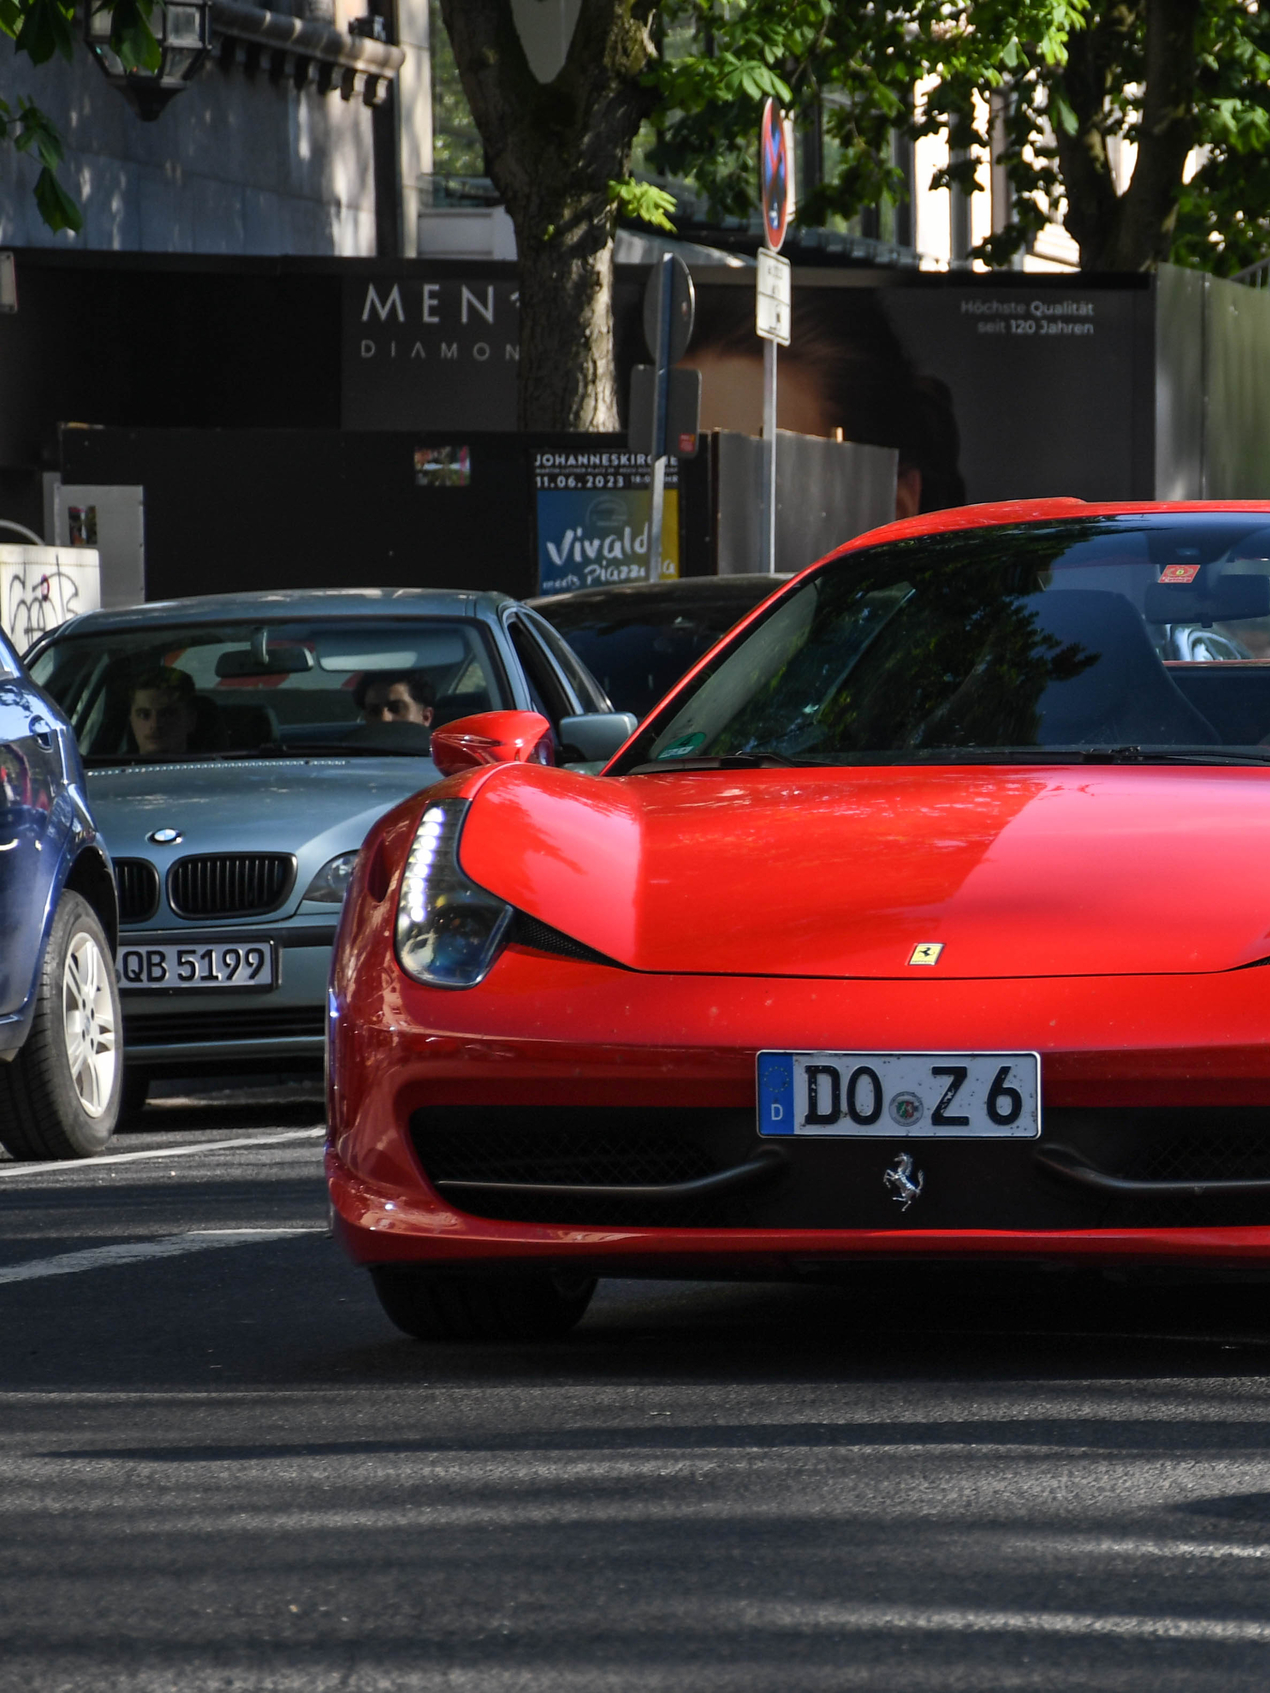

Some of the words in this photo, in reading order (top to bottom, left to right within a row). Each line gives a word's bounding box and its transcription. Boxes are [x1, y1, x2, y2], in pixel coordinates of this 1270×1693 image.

[960, 300, 1027, 314] Höchste
[1030, 300, 1095, 317] Qualität
[977, 320, 1007, 334] seit
[1010, 319, 1036, 335] 120
[1039, 319, 1095, 335] Jahren
[535, 453, 678, 467] JOHANNESKIRE
[535, 474, 625, 489] 11.06.2023
[546, 520, 651, 566] Vivald
[122, 949, 169, 984] QB
[176, 947, 267, 982] 5199
[804, 1065, 883, 1126] DO
[930, 1065, 970, 1127] Z
[986, 1065, 1023, 1127] 6
[770, 1103, 784, 1121] D
